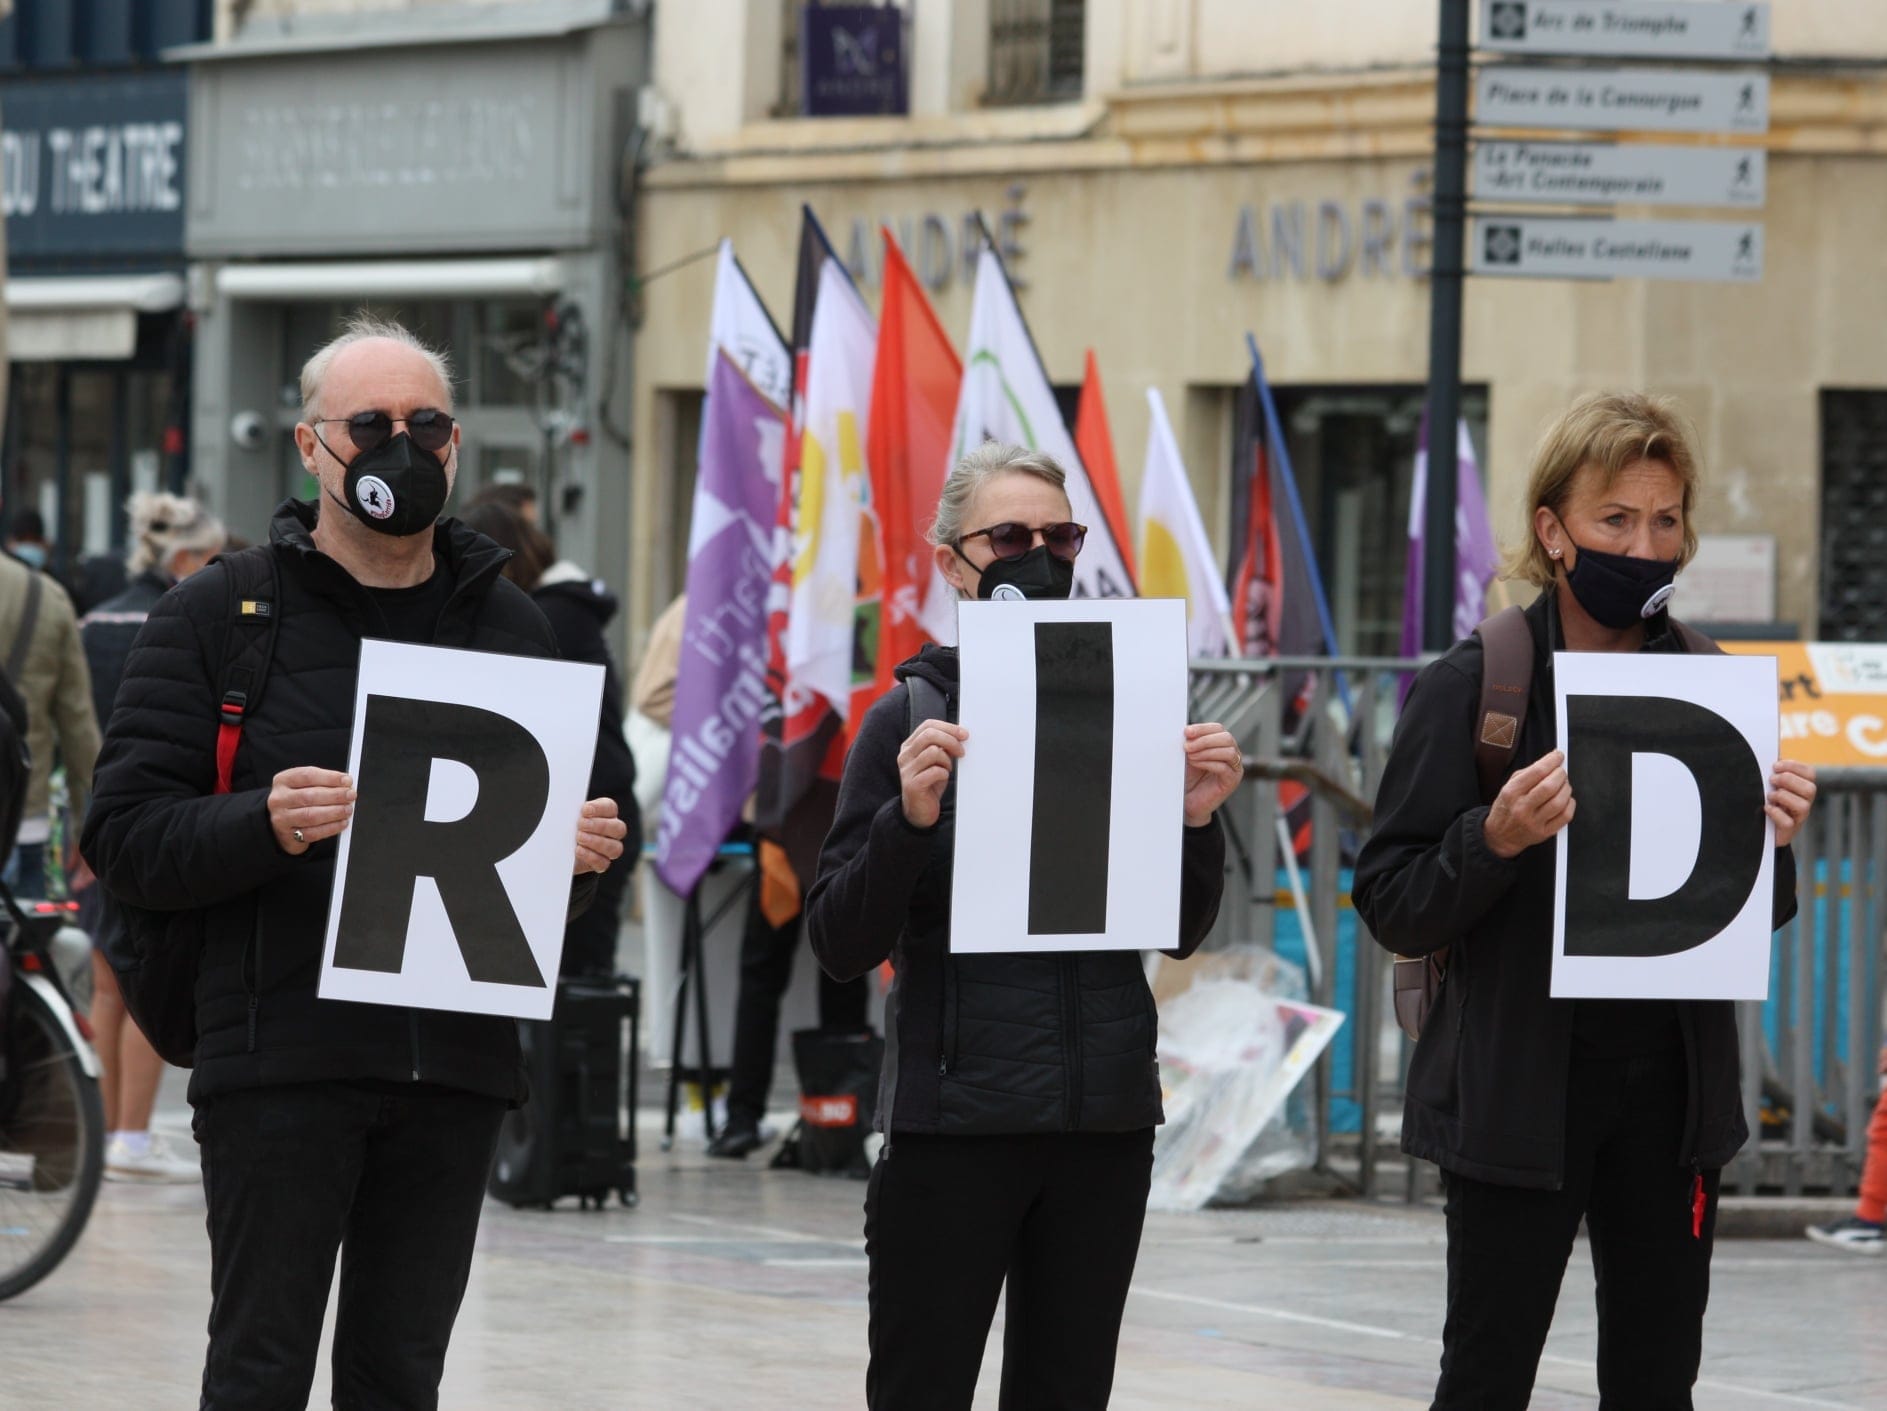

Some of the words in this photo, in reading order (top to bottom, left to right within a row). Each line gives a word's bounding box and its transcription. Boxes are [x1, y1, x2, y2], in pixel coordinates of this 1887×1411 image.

[1533, 9, 1564, 30] Arc
[1573, 12, 1594, 30] de
[1603, 10, 1690, 40] Triomphe
[1487, 82, 1541, 103] Place
[1549, 86, 1569, 105] de
[1530, 171, 1665, 197] Contemporain
[1226, 166, 1434, 285] ANDRÉ
[1527, 237, 1586, 260] Halles
[1593, 238, 1693, 264] Castellane
[1780, 672, 1823, 701] rt
[1028, 621, 1114, 935] I
[333, 693, 550, 988] R
[1563, 694, 1765, 958] D
